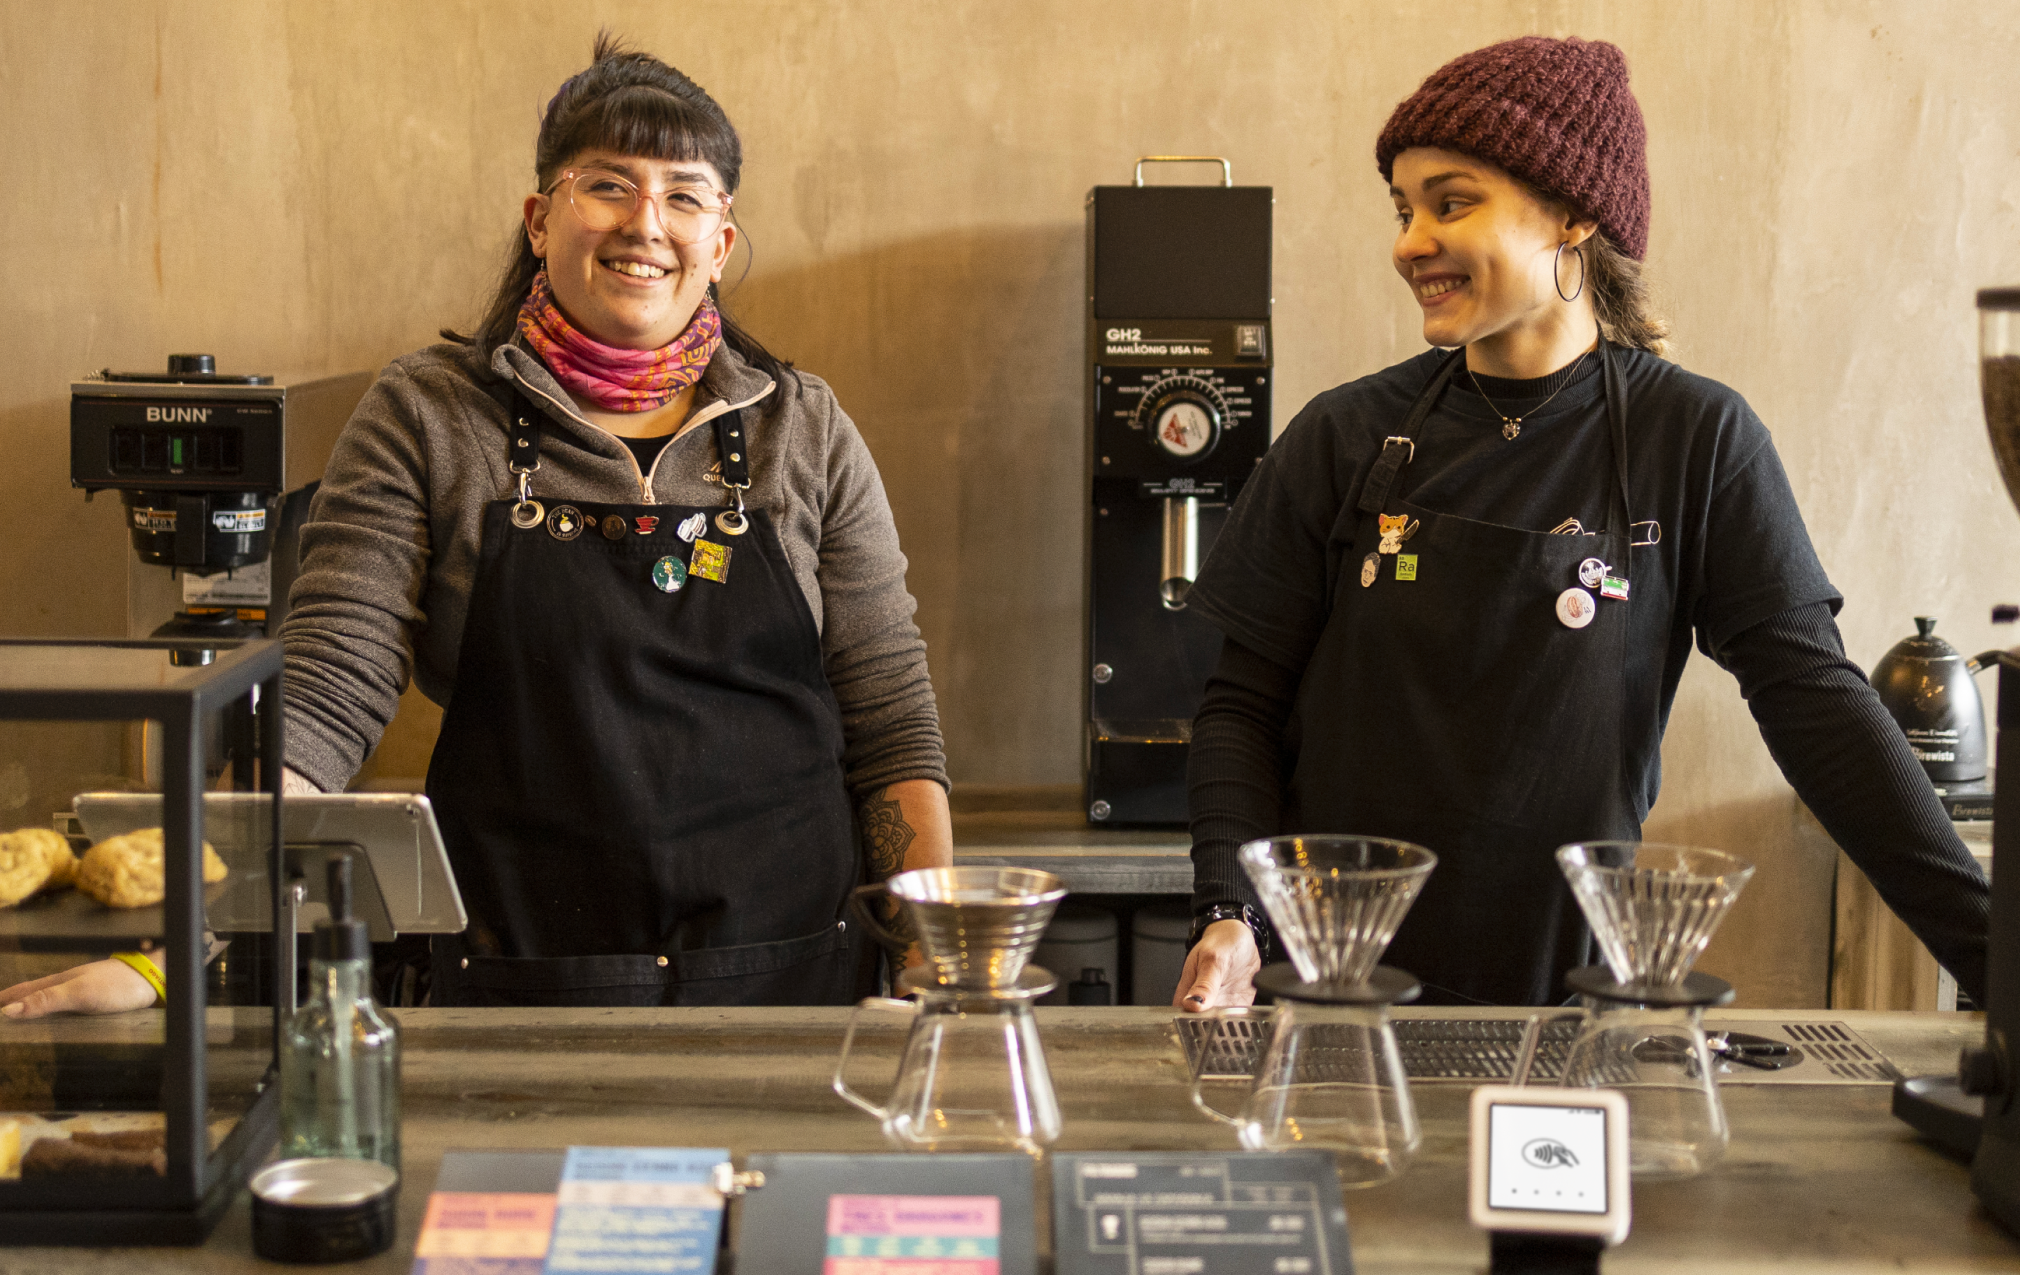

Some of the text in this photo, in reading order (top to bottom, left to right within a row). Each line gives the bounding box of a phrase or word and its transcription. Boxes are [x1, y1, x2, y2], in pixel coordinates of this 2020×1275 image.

[1106, 328, 1141, 341] GH2
[1170, 345, 1191, 354] USA
[1193, 345, 1212, 354] Inc.
[146, 406, 207, 423] BUNN
[703, 473, 722, 482] QUE
[1399, 561, 1415, 571] Ra
